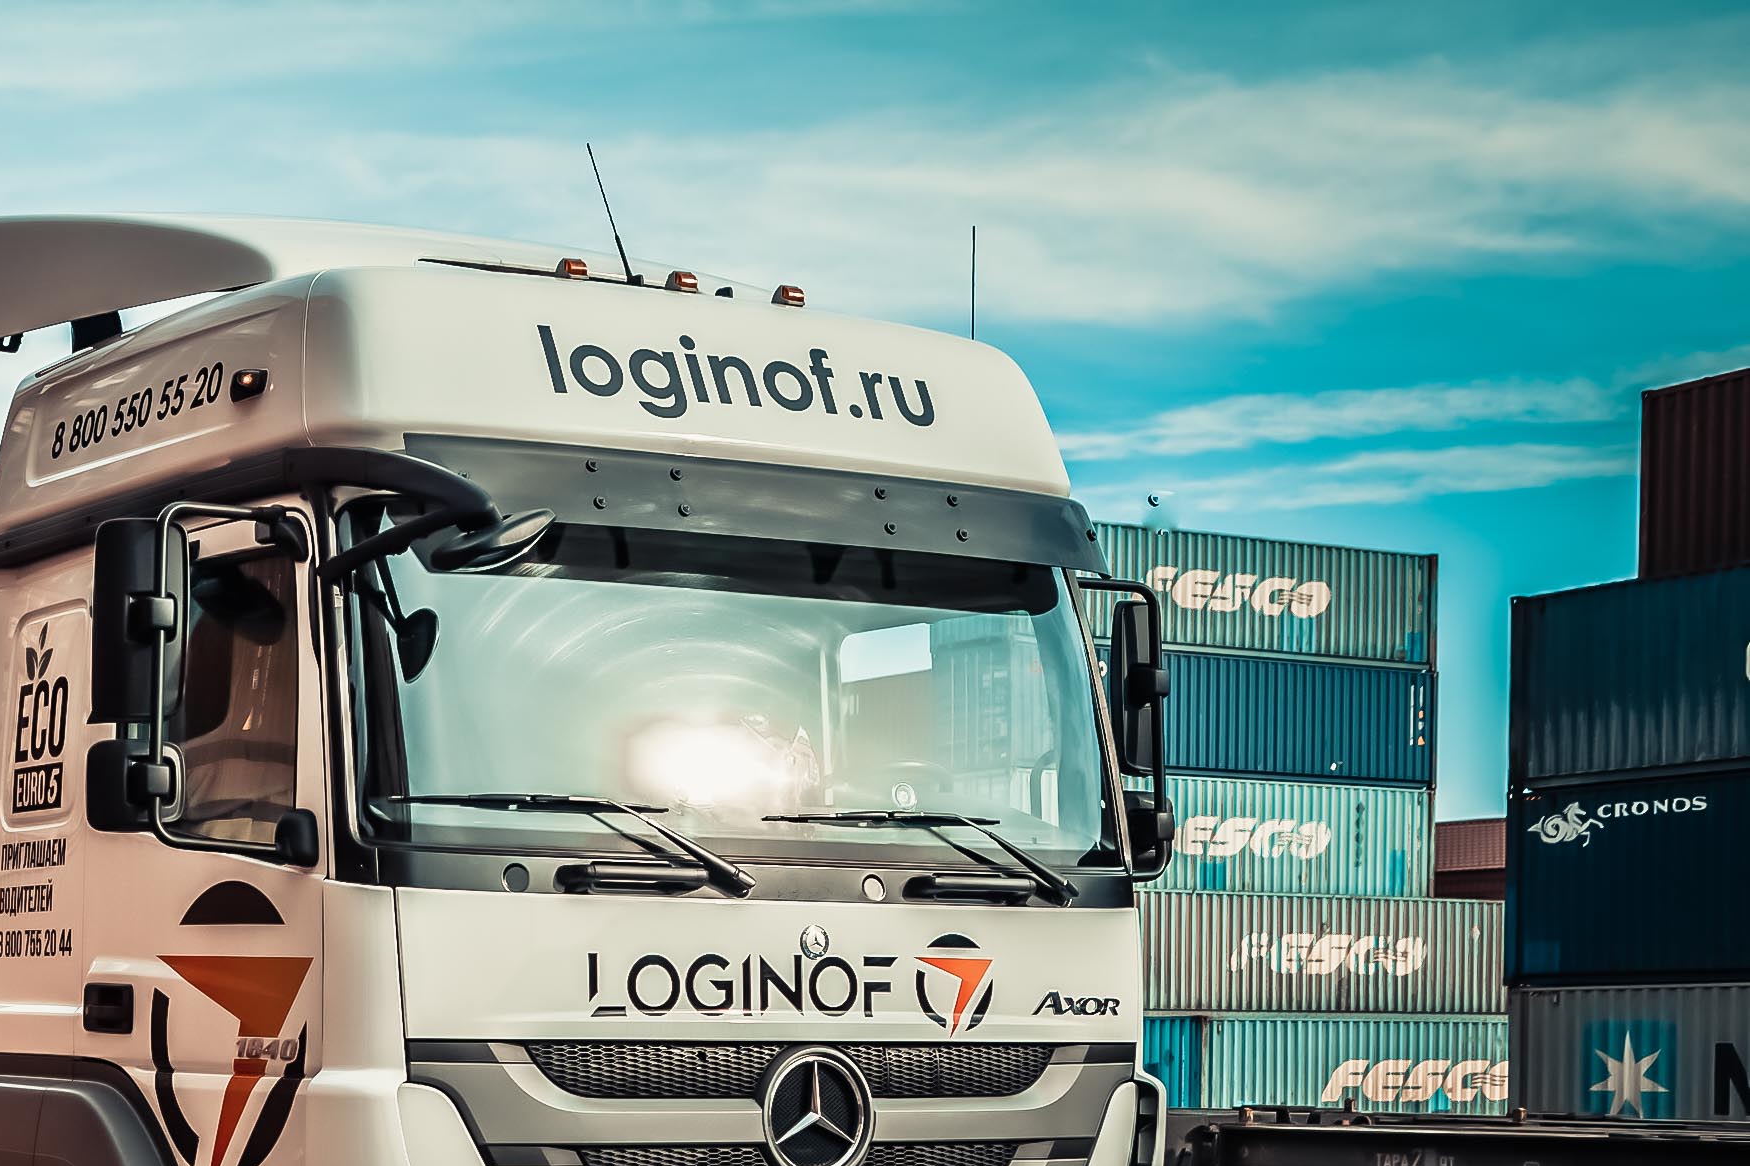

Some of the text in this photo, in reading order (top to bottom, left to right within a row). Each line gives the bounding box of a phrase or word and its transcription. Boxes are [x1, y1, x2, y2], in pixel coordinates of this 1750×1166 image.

[537, 325, 935, 427] loginof.ru
[51, 362, 224, 460] 8 800 550 55 20
[15, 676, 69, 763] ECO
[16, 767, 59, 808] EURO 5
[1597, 796, 1708, 819] CRONOS
[1, 838, 67, 871] ПРИГЛАШАЕМ
[1172, 815, 1331, 859] ESCO
[0, 878, 53, 917] ВОДИТЕЛЕЙ
[5, 930, 23, 957] 800
[44, 929, 57, 957] 20
[58, 928, 73, 957] 44
[1230, 931, 1428, 977] FESCO
[588, 953, 899, 1018] LOGINOF
[235, 1038, 299, 1062] 1840
